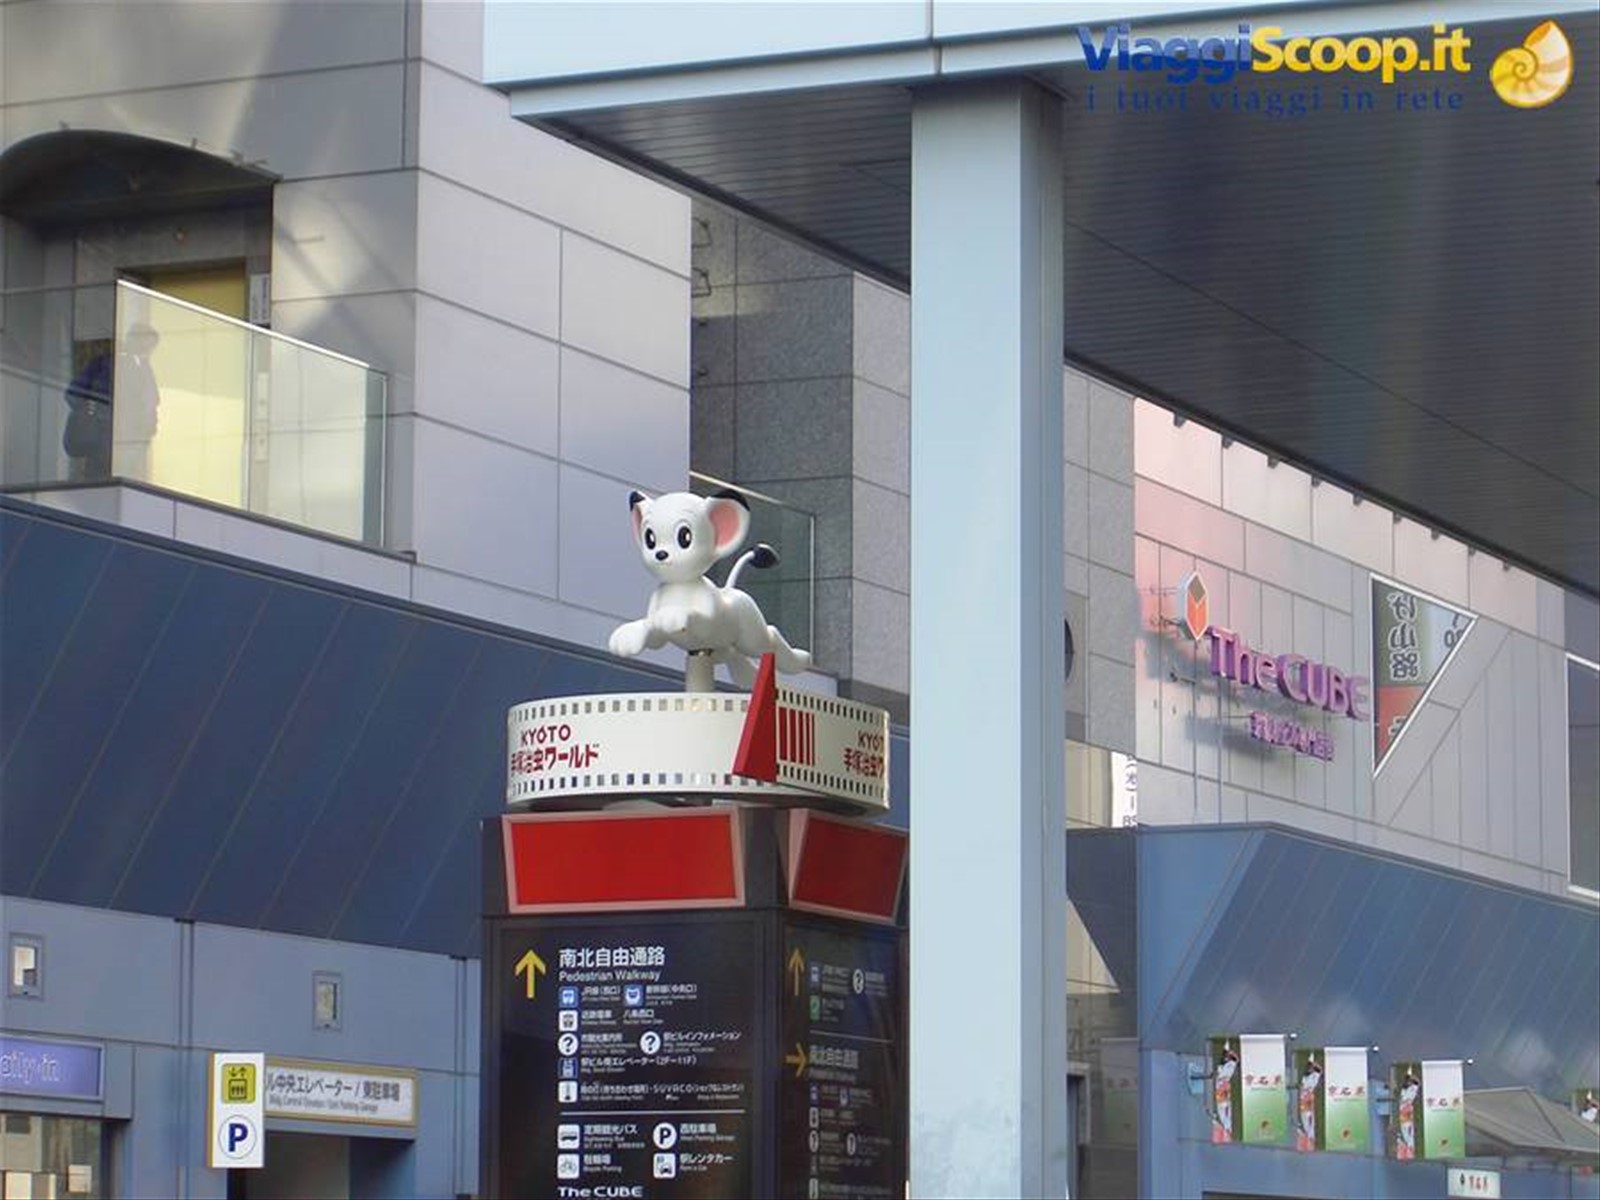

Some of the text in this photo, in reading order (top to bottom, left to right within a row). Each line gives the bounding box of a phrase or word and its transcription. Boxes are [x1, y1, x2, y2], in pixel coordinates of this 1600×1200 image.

[521, 724, 571, 747] KYOTO
[558, 946, 666, 968] 南北自由通路
[558, 969, 661, 983] Pedestrian Walkway
[228, 1122, 248, 1153] P
[659, 1127, 671, 1145] P
[558, 1186, 644, 1198] The CUBE
